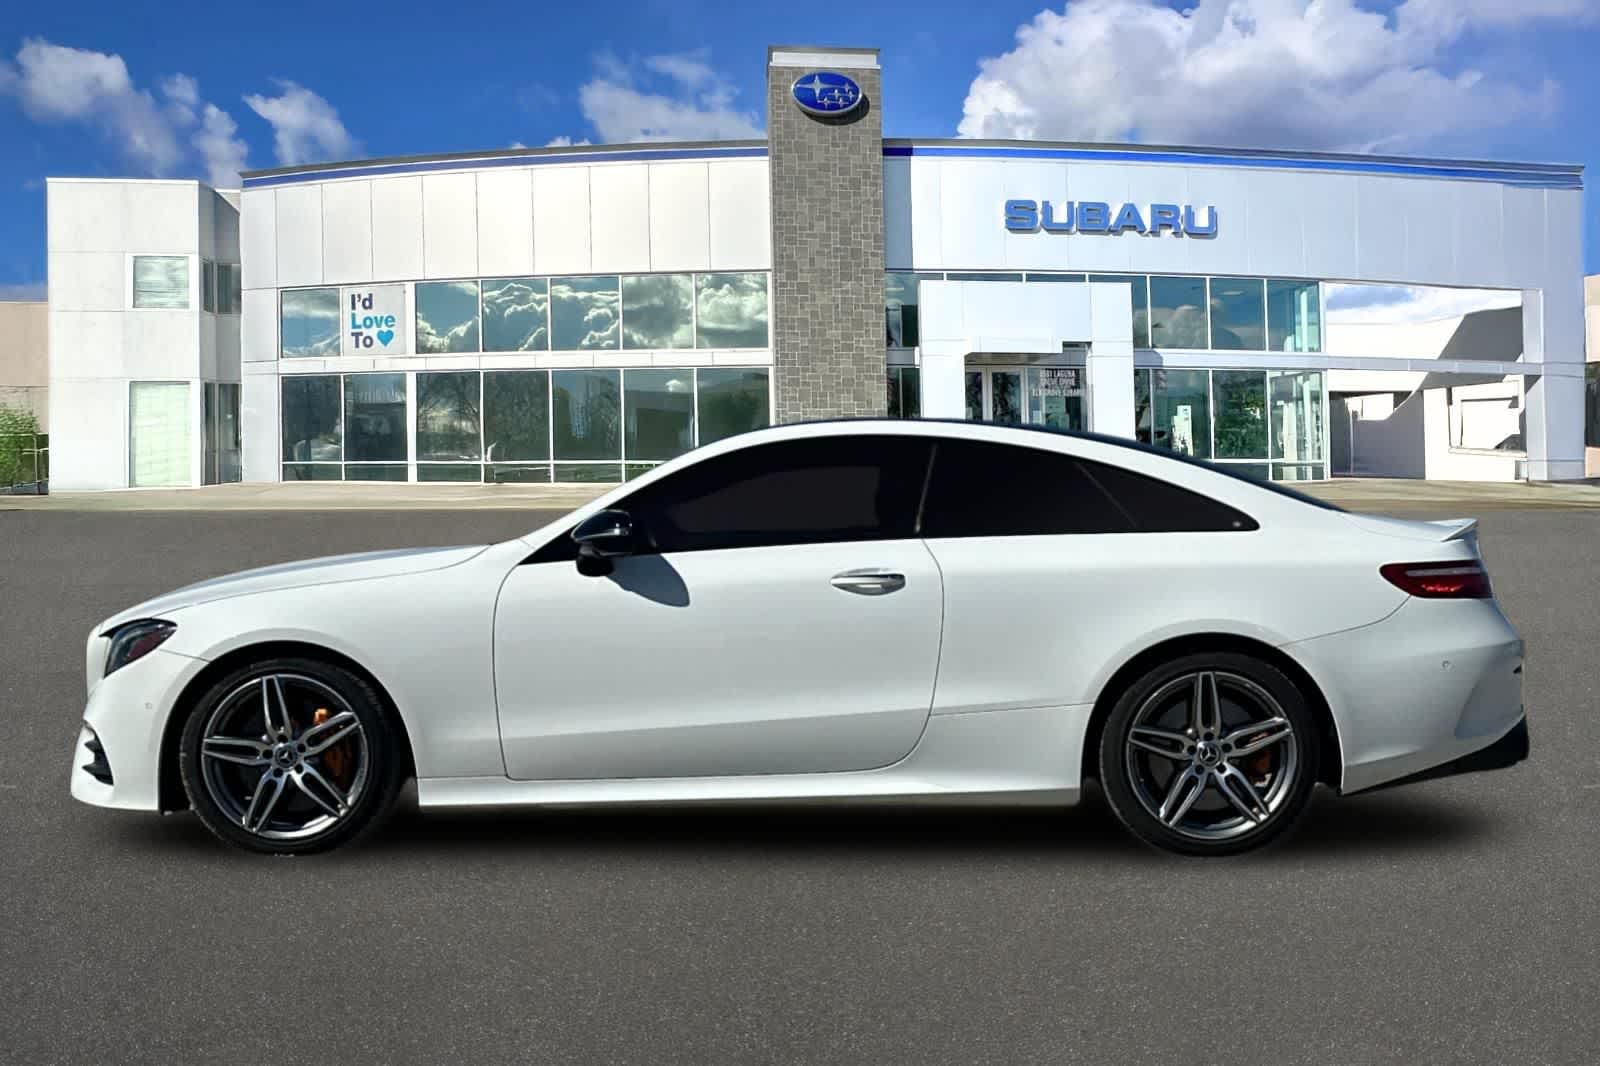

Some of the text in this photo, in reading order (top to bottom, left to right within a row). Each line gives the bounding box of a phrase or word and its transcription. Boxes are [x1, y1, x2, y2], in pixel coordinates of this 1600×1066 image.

[1005, 199, 1218, 237] SUBARU
[351, 293, 373, 310] I'd
[351, 313, 396, 329] Love
[351, 331, 374, 349] To
